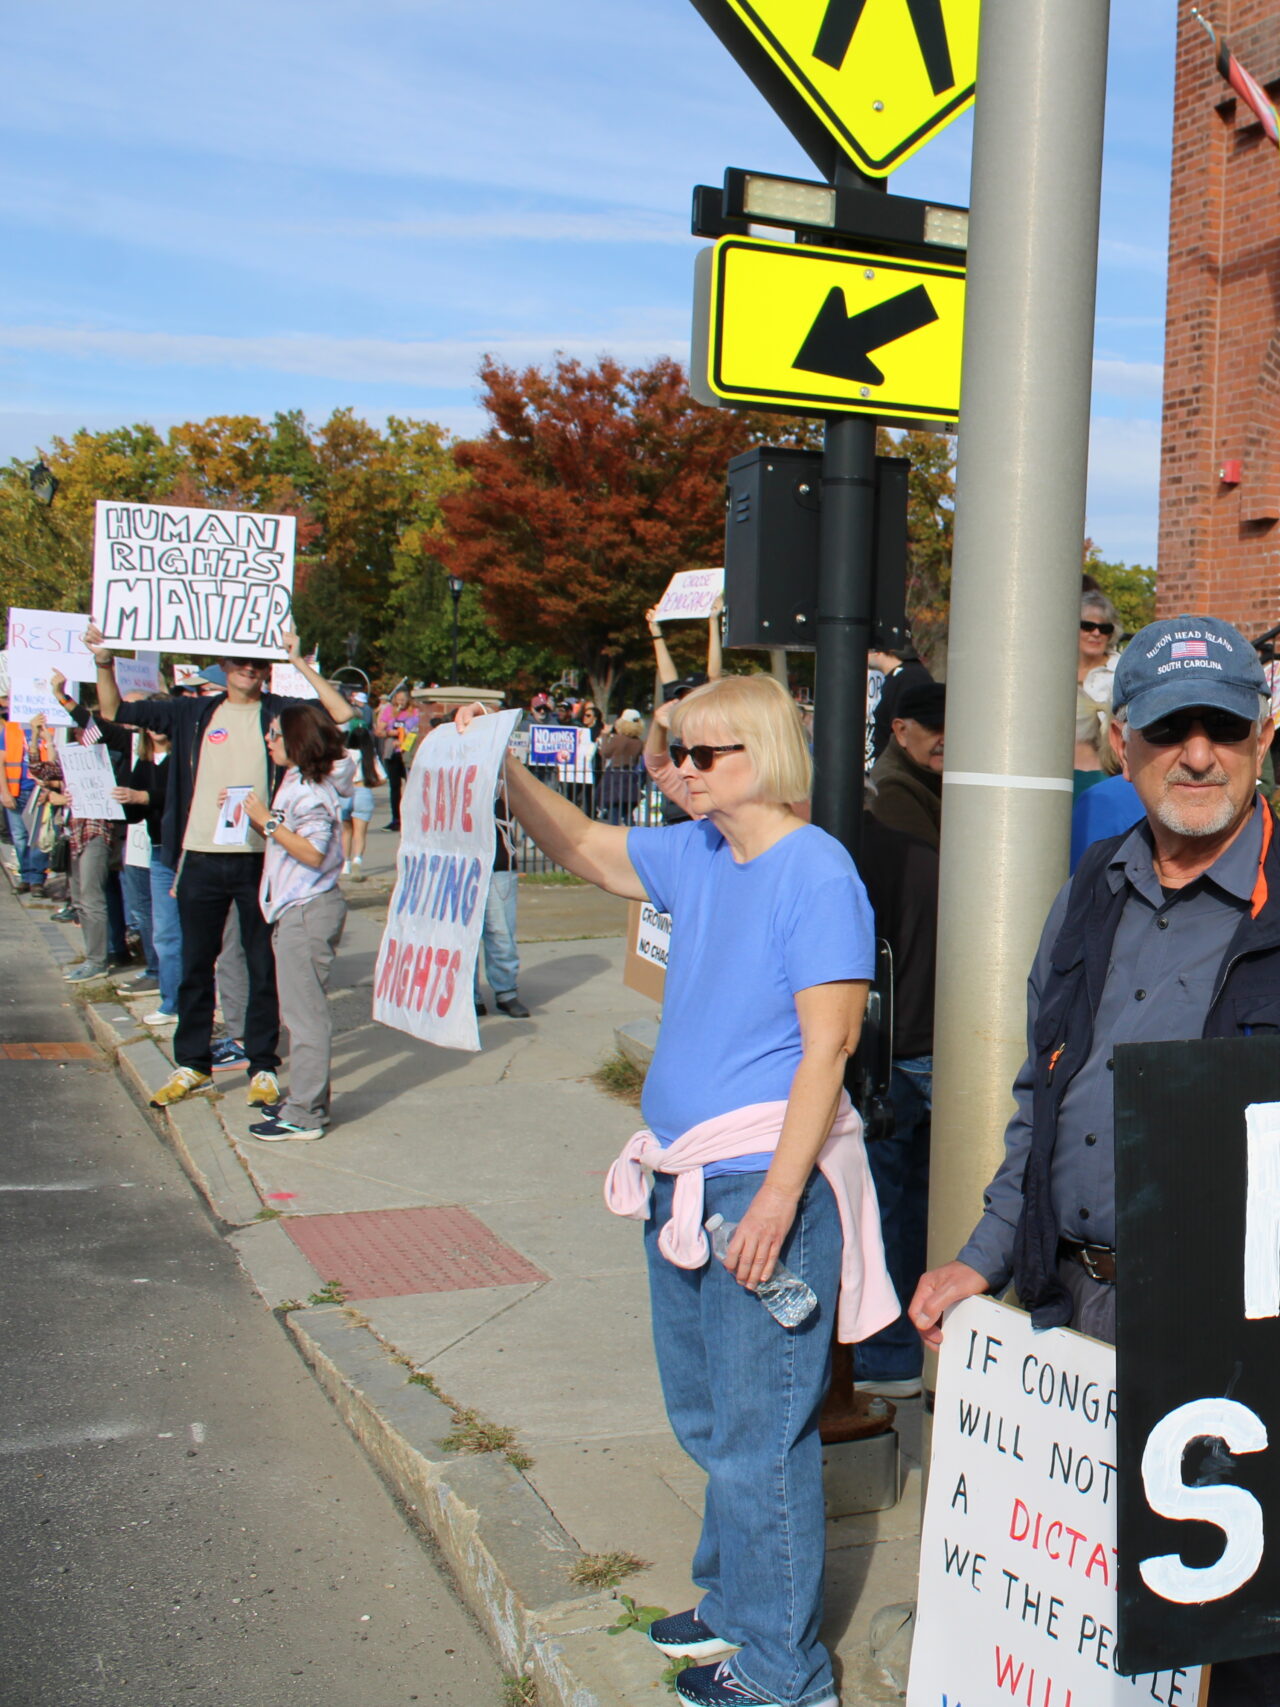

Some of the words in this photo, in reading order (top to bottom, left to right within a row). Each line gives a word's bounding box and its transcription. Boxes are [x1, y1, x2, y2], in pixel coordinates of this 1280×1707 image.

[106, 507, 280, 550] HUMAN
[111, 542, 285, 582] RIGHTS
[102, 578, 292, 649] MATTER
[1146, 633, 1172, 659] HILTON
[1175, 630, 1201, 639] HEAD
[1205, 631, 1233, 652] ISLAND
[1157, 661, 1181, 675] SOUTH
[1184, 659, 1222, 671] CAROLINA
[534, 727, 550, 744] NO
[550, 730, 575, 744] KINGS
[421, 764, 478, 833] SAVE
[397, 852, 482, 927] VOTING
[377, 938, 461, 1018] RIGHTS
[966, 1329, 1003, 1374] IF
[1022, 1353, 1117, 1430] CONGR
[959, 1398, 1024, 1461] WILL
[1049, 1441, 1117, 1504] NOT
[951, 1472, 968, 1515] A
[1009, 1497, 1117, 1594] DICTA
[944, 1538, 987, 1592] WE
[1003, 1568, 1065, 1640] THE
[1077, 1613, 1188, 1707] PELE
